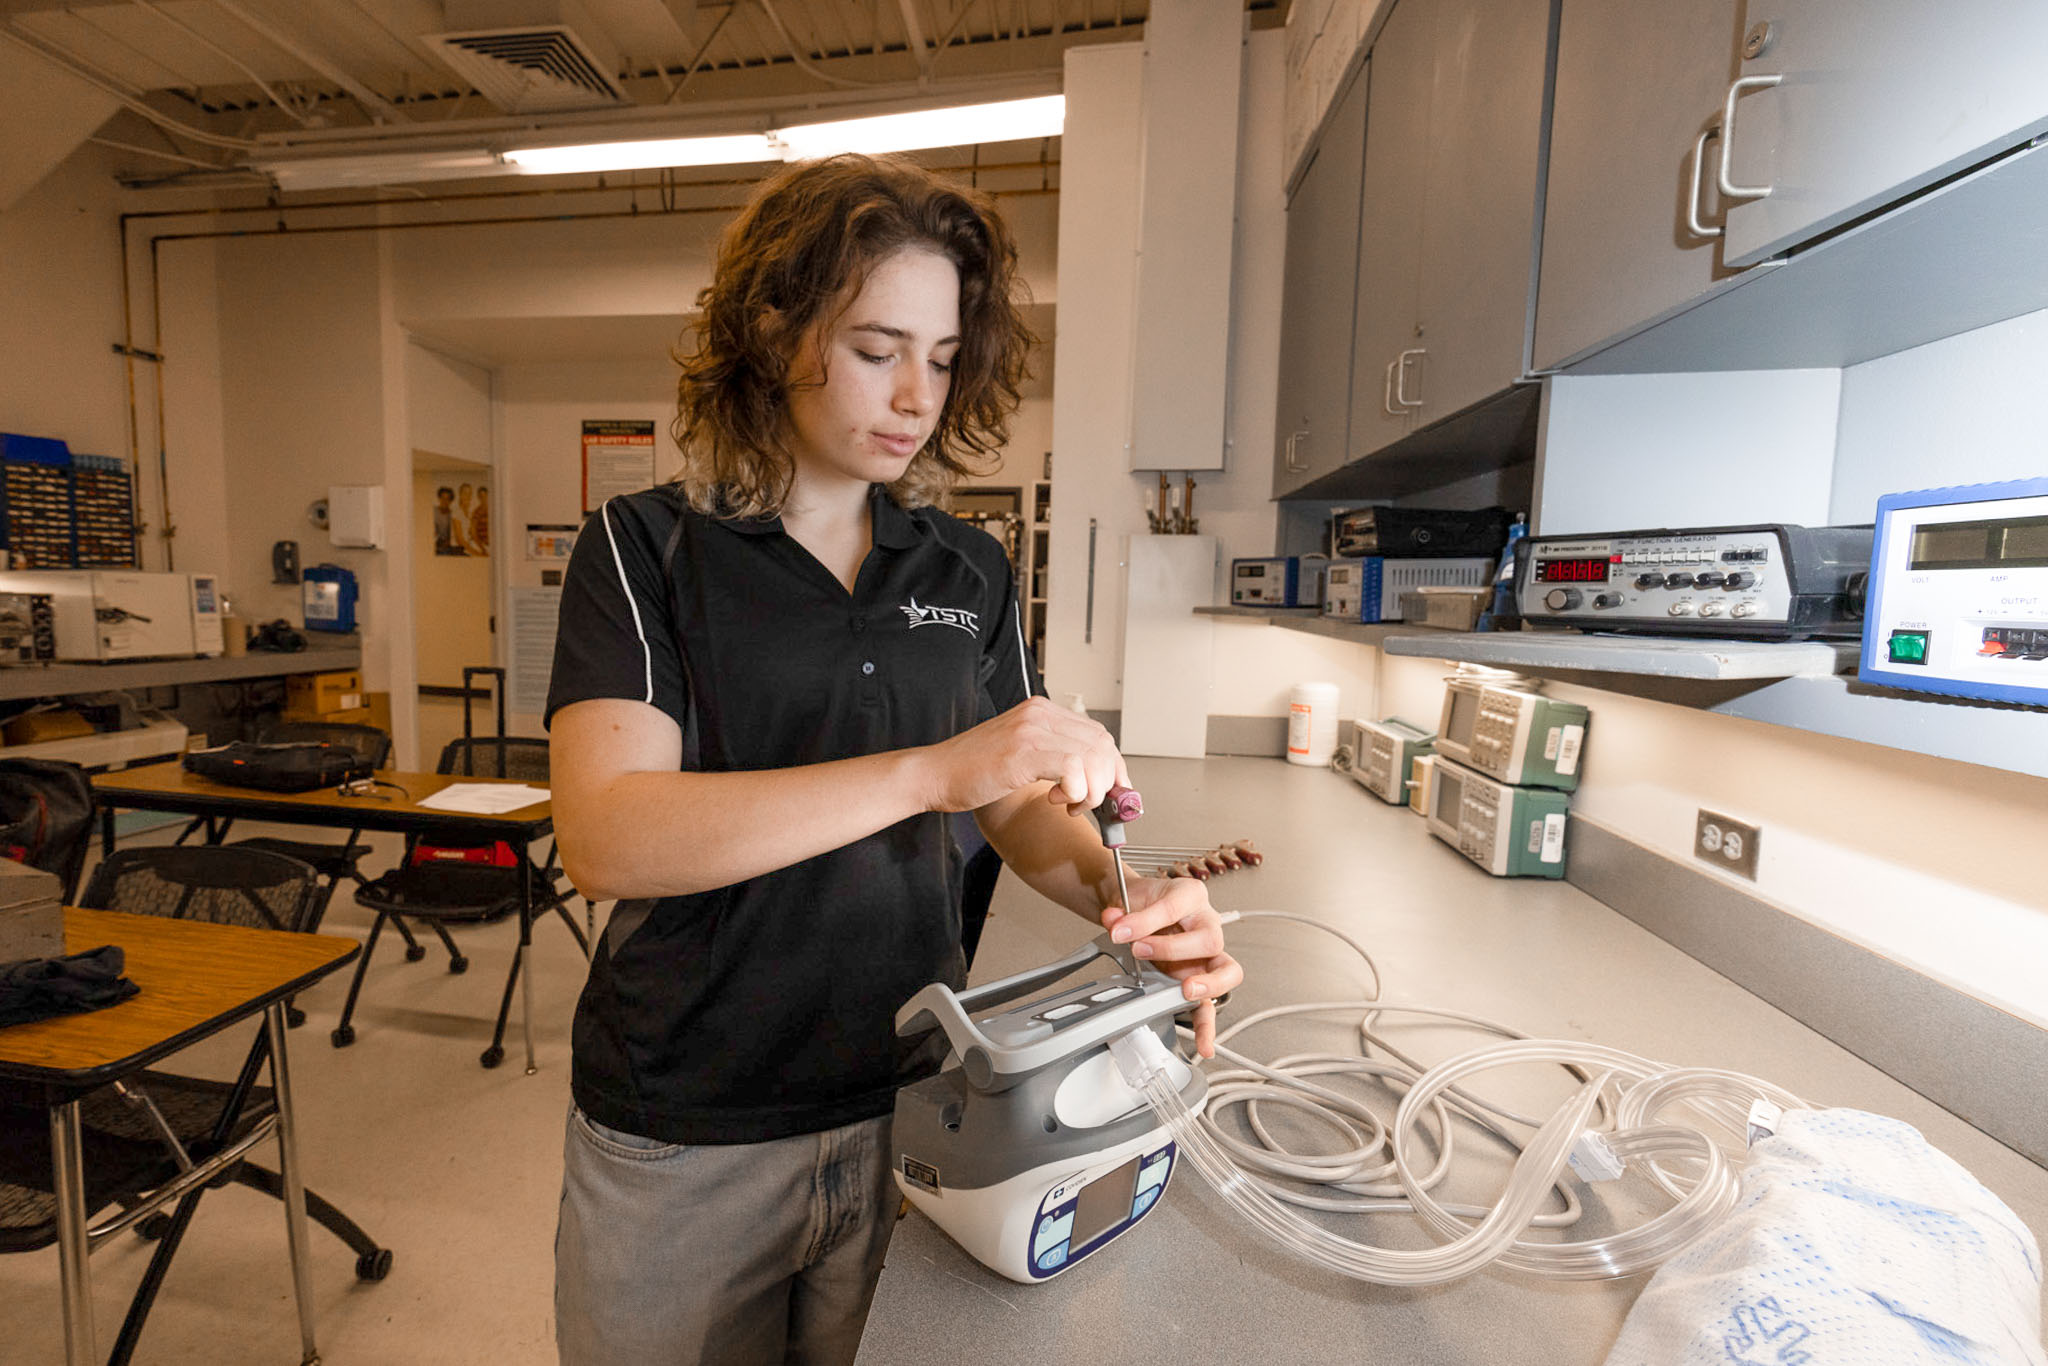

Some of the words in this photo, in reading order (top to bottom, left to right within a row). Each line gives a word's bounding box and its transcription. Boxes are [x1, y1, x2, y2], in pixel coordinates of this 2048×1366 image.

[1637, 537, 1671, 545] FUNCTION
[1674, 535, 1717, 544] GENERATOR
[1911, 576, 1929, 584] VOLT
[2000, 597, 2039, 605] OUTPUT
[924, 605, 980, 632] TSTC
[1899, 621, 1927, 629] POWER
